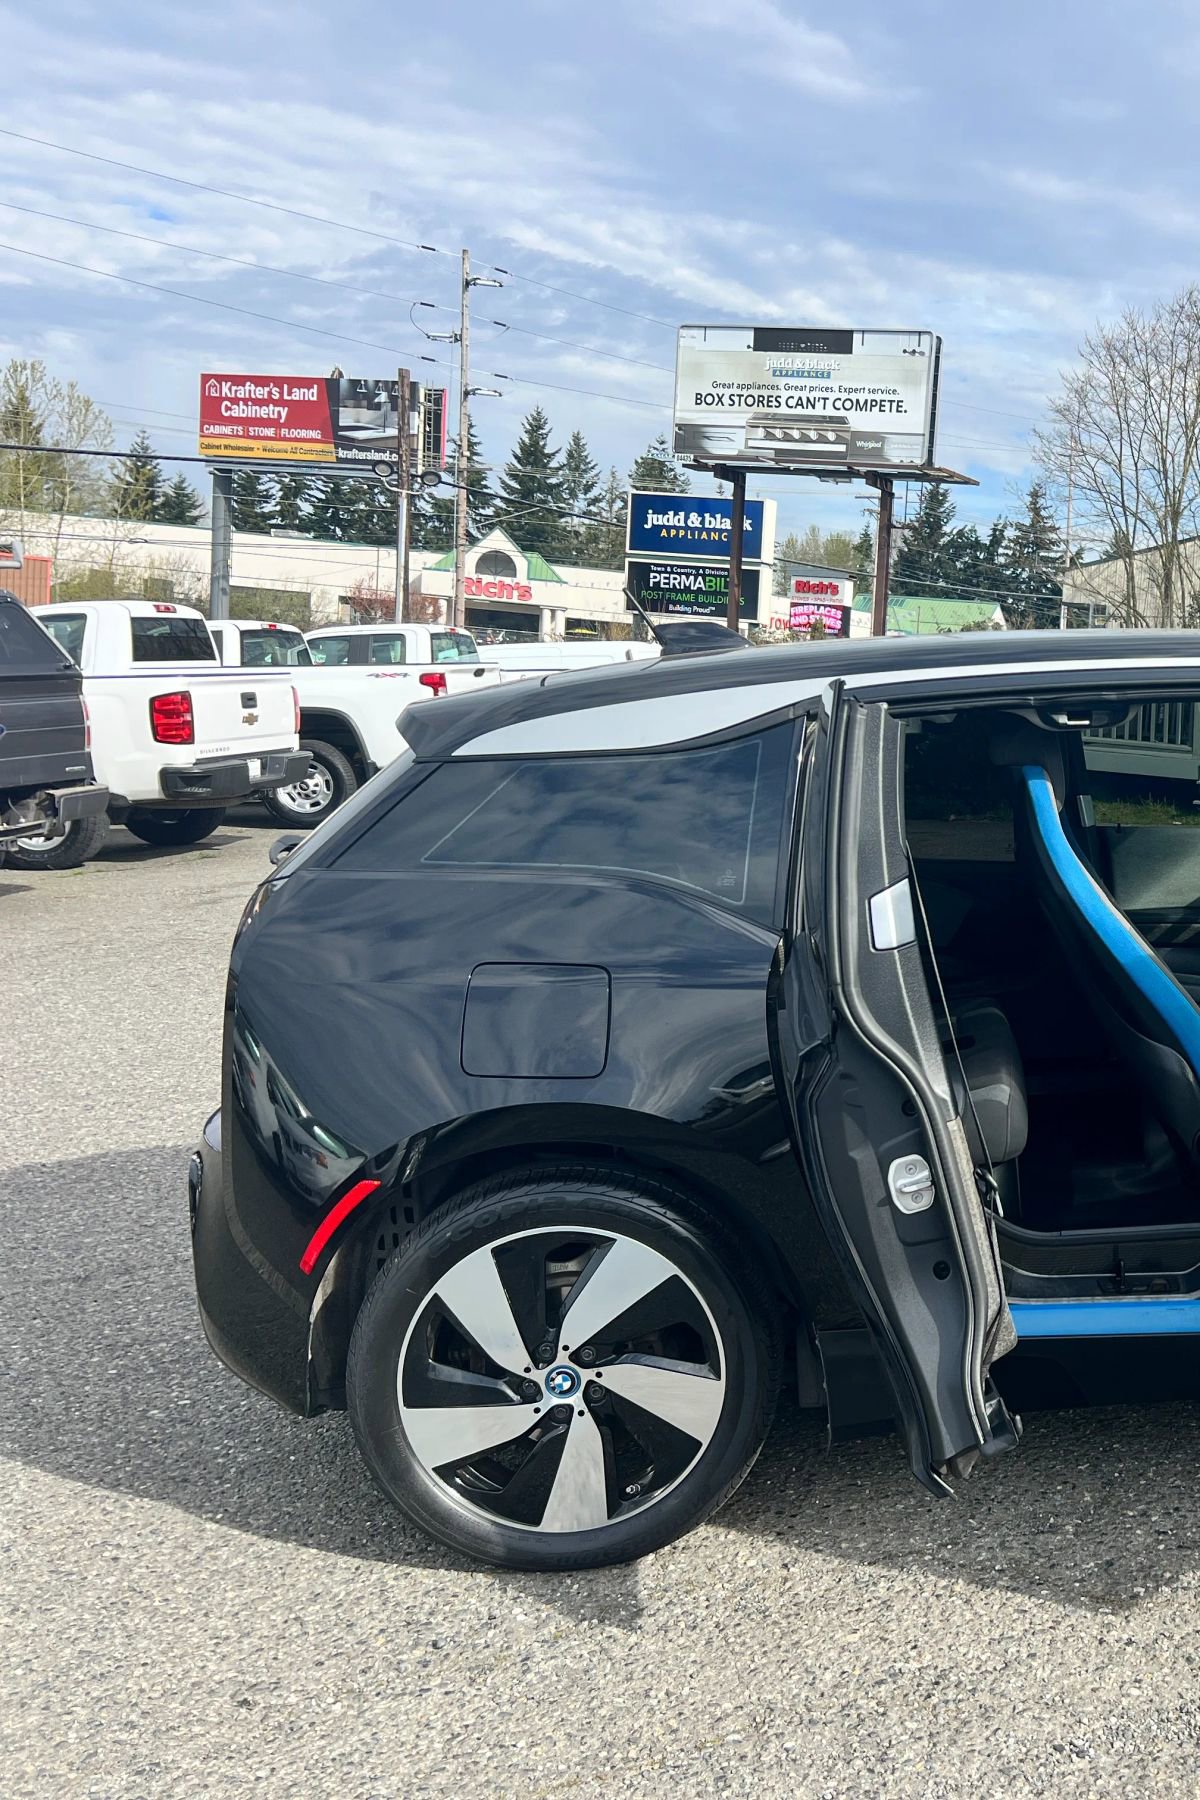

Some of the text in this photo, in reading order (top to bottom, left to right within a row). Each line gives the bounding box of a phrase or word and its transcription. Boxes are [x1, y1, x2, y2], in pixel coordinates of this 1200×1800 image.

[764, 357, 793, 371] judd
[806, 358, 840, 371] black
[774, 369, 829, 378] APPLIANCE
[221, 381, 280, 399] Krafter's
[283, 383, 318, 401] Land
[711, 380, 900, 395] Great appliances. Great prices. Expert service.
[694, 392, 908, 414] BOX STORES CAN'T COMPETE.
[221, 400, 289, 423] Cabinetry
[203, 424, 322, 439] CABINETS STONE FLOORING
[200, 442, 222, 450] Cabinet
[855, 440, 882, 450] Whirlpool
[338, 447, 399, 461] kraftersland.c
[643, 509, 753, 531] judd & blak
[660, 528, 729, 542] APPLIANC
[705, 568, 729, 576] Division
[463, 576, 533, 601] Rich's
[649, 572, 730, 592] PERMABIL
[795, 579, 839, 596] Rich's
[641, 590, 745, 606] POST FRAME BUILDIS
[668, 604, 692, 614] Building
[790, 604, 843, 620] FIREPLACES
[790, 614, 809, 627] AND
